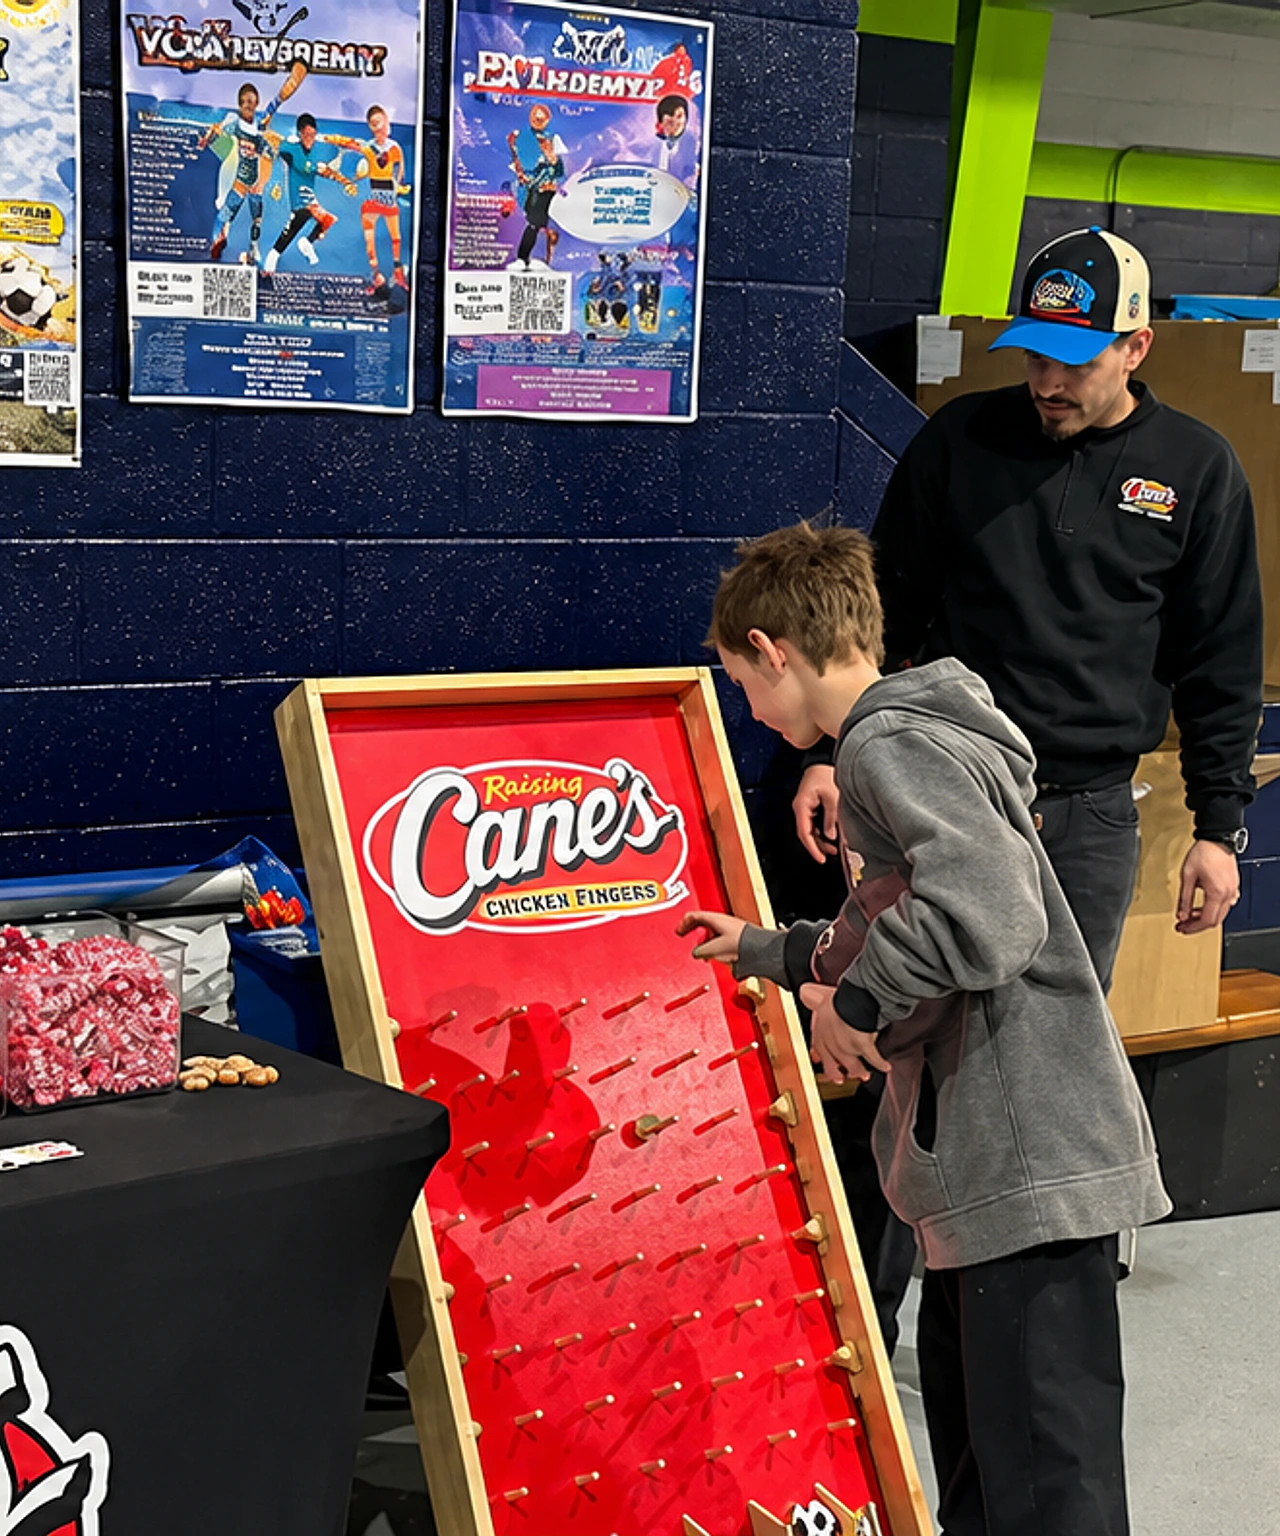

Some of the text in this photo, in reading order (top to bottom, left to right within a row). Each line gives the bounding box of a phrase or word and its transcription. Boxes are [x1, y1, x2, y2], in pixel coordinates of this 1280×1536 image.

[482, 772, 584, 806] Raising
[390, 759, 680, 929] Cane's
[485, 882, 657, 919] CHICKEN FINGERS
